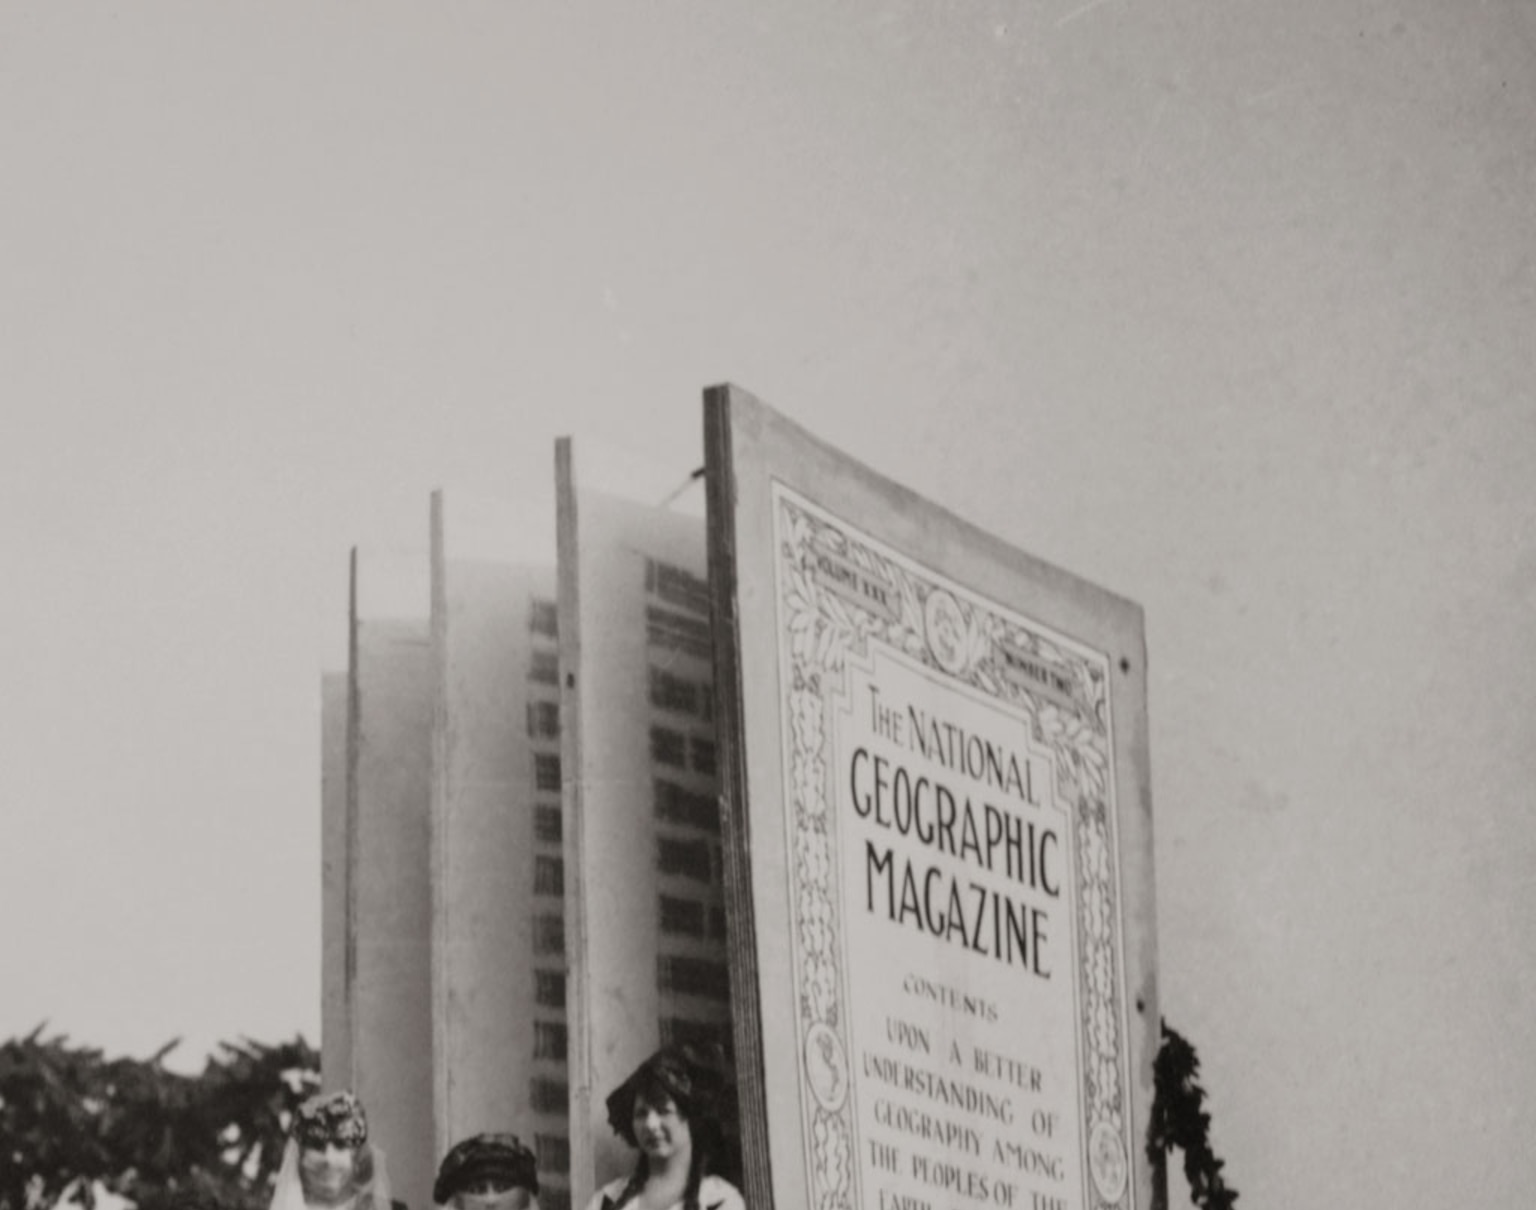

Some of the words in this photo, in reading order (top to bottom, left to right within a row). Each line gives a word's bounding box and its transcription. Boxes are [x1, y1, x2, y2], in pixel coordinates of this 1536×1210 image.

[908, 704, 1041, 809] NATIONAL
[850, 746, 1060, 898] GEOGRAPHIC
[865, 838, 1052, 980] MAGAZINE
[863, 1050, 1014, 1125] UNDERSTANDING
[1030, 1108, 1056, 1138] OF
[885, 1016, 930, 1054] UPON
[948, 1039, 962, 1067] A
[973, 1047, 1043, 1094] BETTER
[868, 1138, 899, 1174] THE
[912, 1153, 990, 1200] PEOPLES
[992, 1179, 1015, 1209] OF
[873, 1097, 981, 1157] GEOGRAPHY
[992, 1137, 1064, 1182] AMONG
